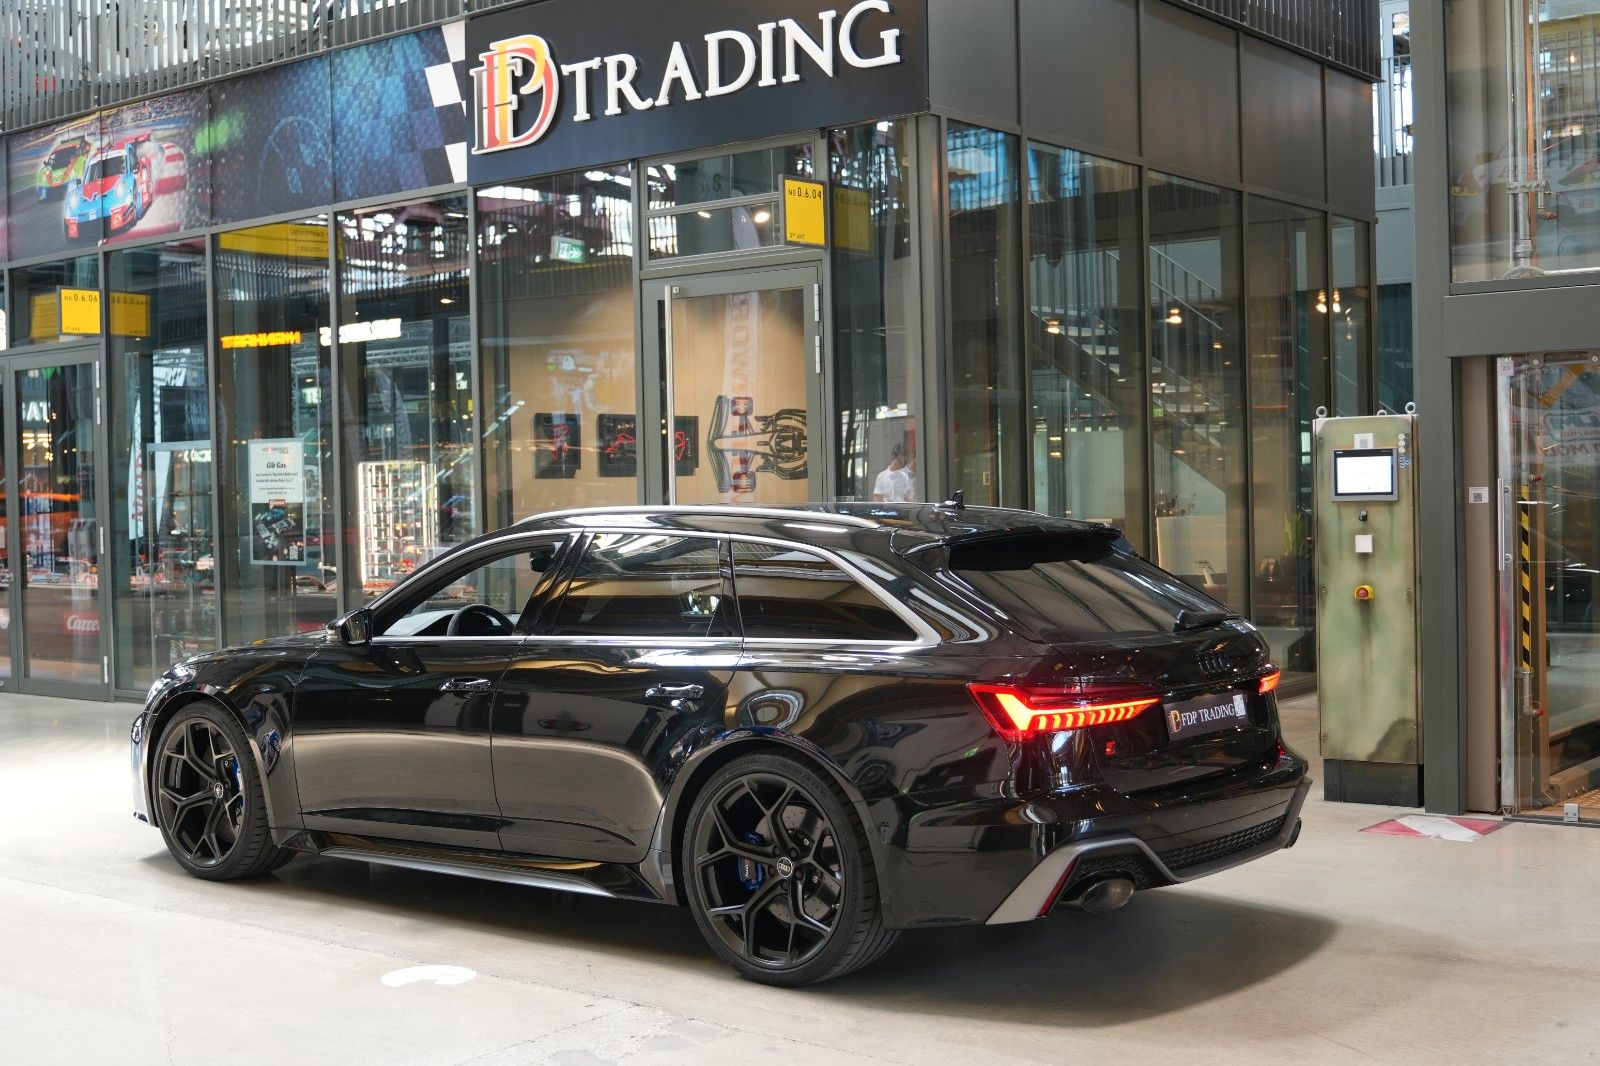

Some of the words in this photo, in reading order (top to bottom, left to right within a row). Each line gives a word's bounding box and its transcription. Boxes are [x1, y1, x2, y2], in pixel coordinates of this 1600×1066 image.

[562, 0, 901, 122] TRADING
[797, 186, 822, 201] 0.6.04
[1181, 711, 1197, 726] FDP
[1198, 703, 1235, 722] TRADING
